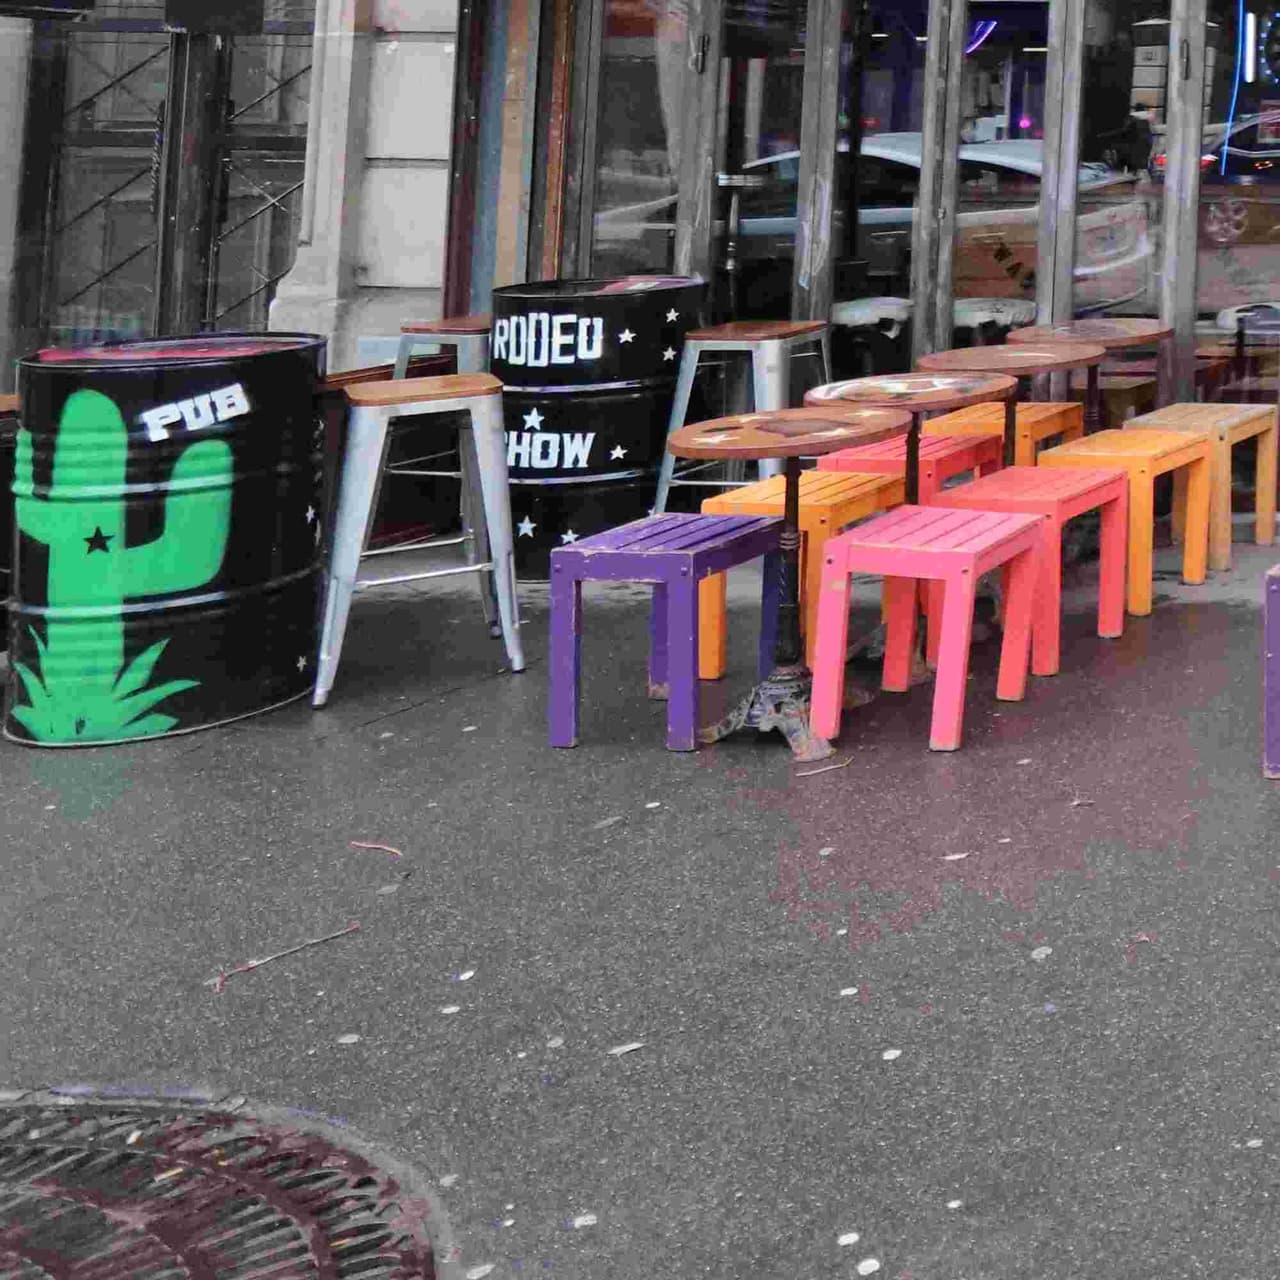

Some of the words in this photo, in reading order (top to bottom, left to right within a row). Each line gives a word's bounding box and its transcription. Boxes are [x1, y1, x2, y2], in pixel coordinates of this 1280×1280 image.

[493, 312, 604, 368] RODEO
[140, 382, 251, 442] PUB
[503, 430, 597, 469] HOW
